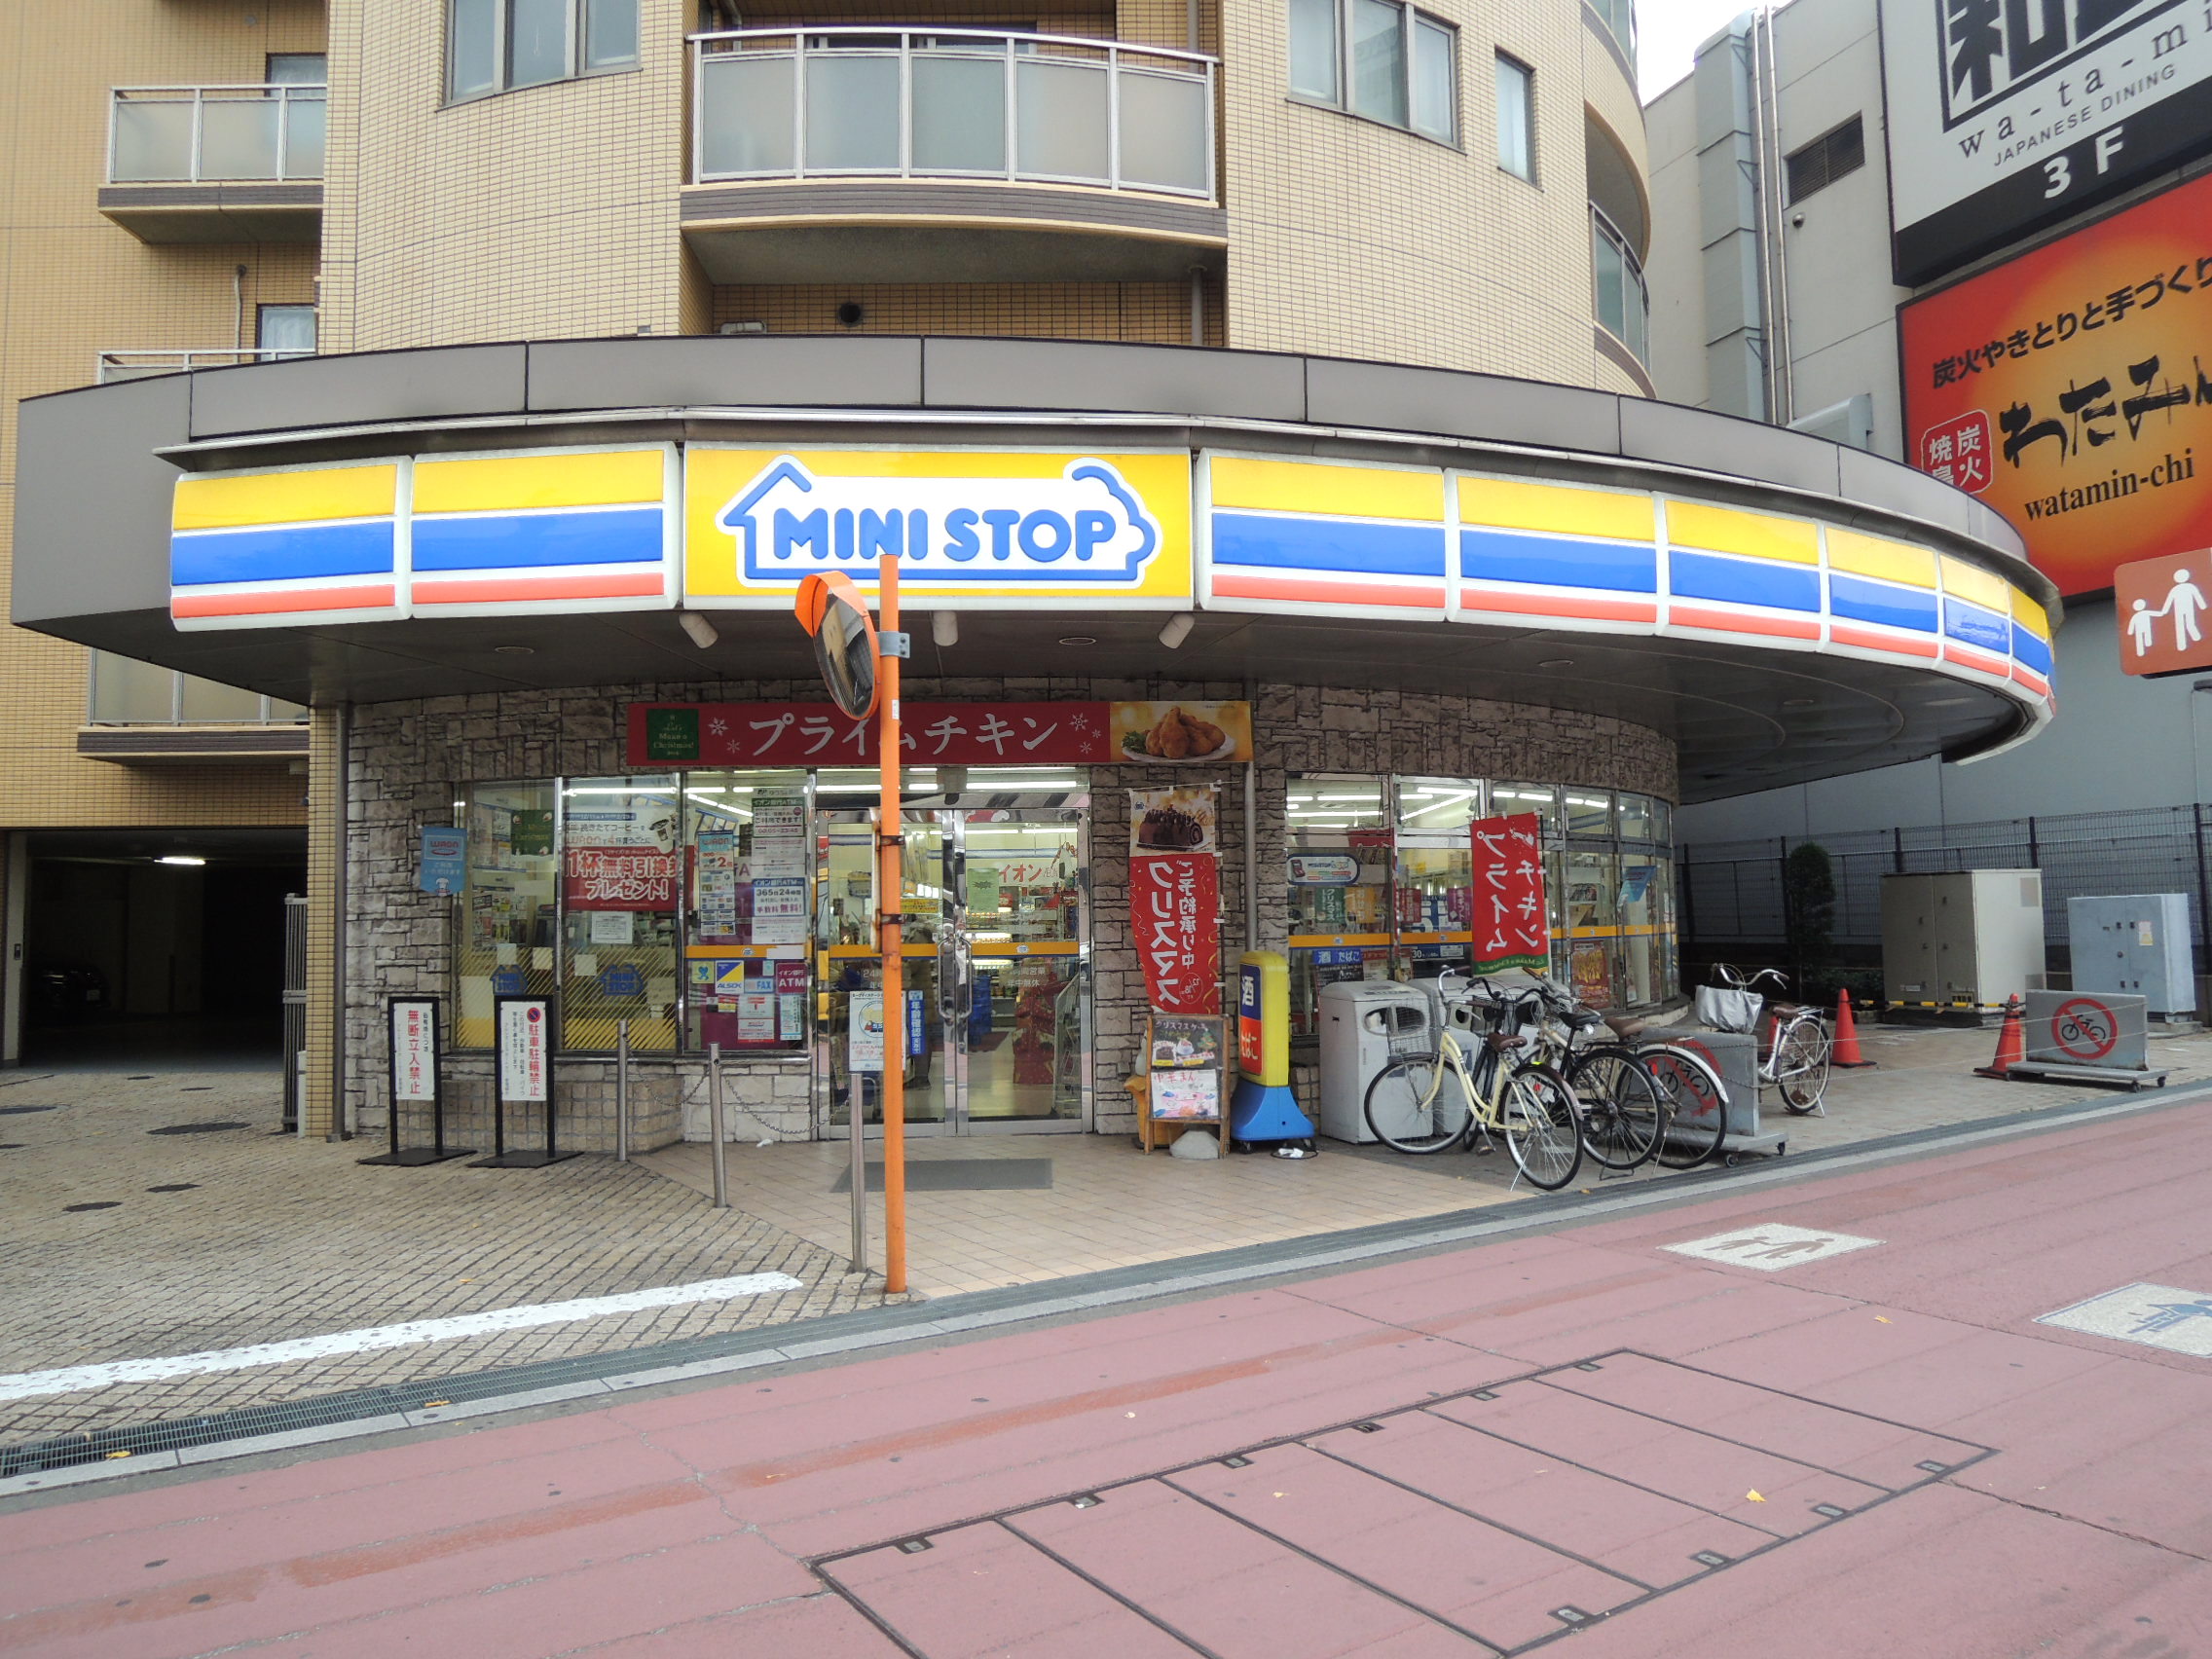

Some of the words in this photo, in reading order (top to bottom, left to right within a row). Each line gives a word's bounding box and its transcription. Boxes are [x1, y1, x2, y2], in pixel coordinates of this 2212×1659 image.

[1994, 105, 2092, 166] JAPANESE
[2101, 63, 2176, 113] DINING
[2024, 448, 2195, 521] watamin-chi
[773, 507, 928, 561] MINI
[943, 507, 1117, 563] STOP
[756, 980, 771, 989] FAX
[779, 977, 804, 987] ATM
[407, 1010, 421, 1094] 無断立入禁止
[529, 1023, 540, 1096] 駐車駐輪禁止
